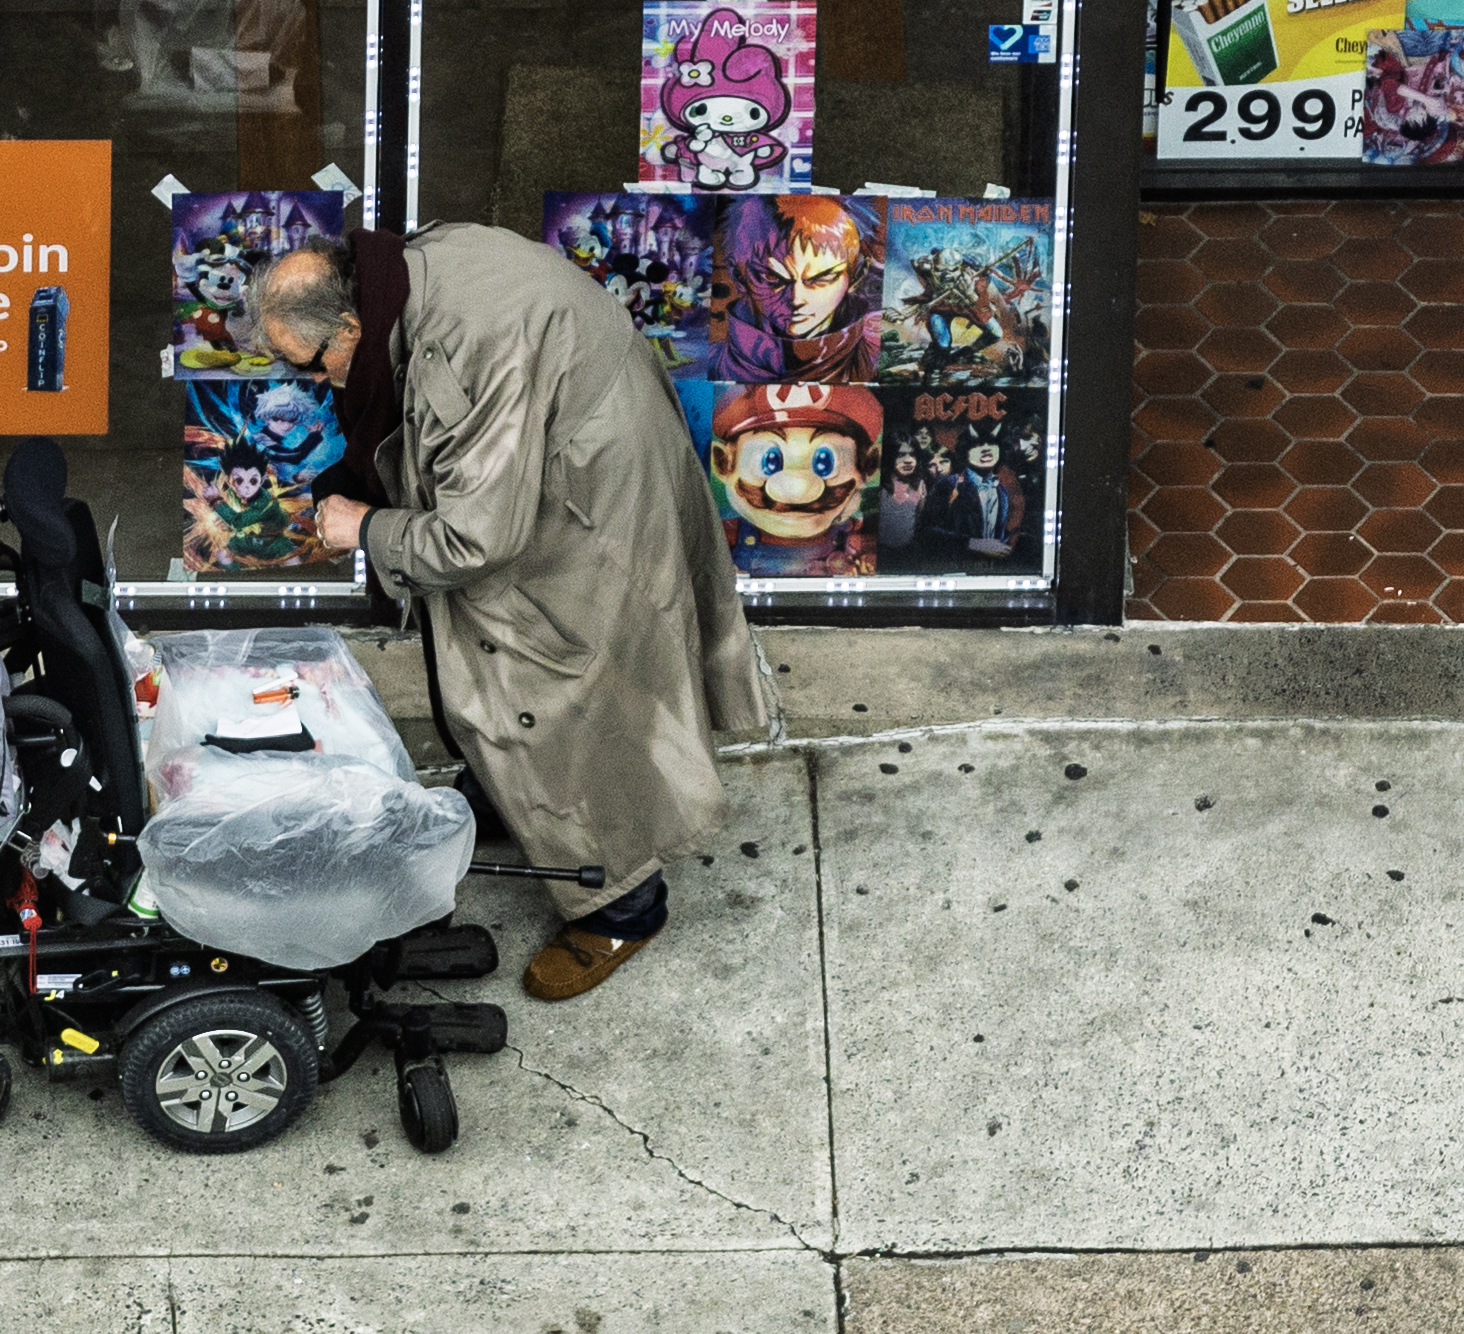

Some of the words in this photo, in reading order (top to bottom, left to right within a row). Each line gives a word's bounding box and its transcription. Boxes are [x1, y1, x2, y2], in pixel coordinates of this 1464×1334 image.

[668, 19, 702, 42] My
[711, 19, 789, 43] Melody
[1335, 37, 1367, 54] Chey
[892, 203, 954, 223] IRON
[958, 203, 1051, 224] MAIDEN
[38, 323, 47, 387] COINFLIP
[44, 990, 65, 1001] J4
